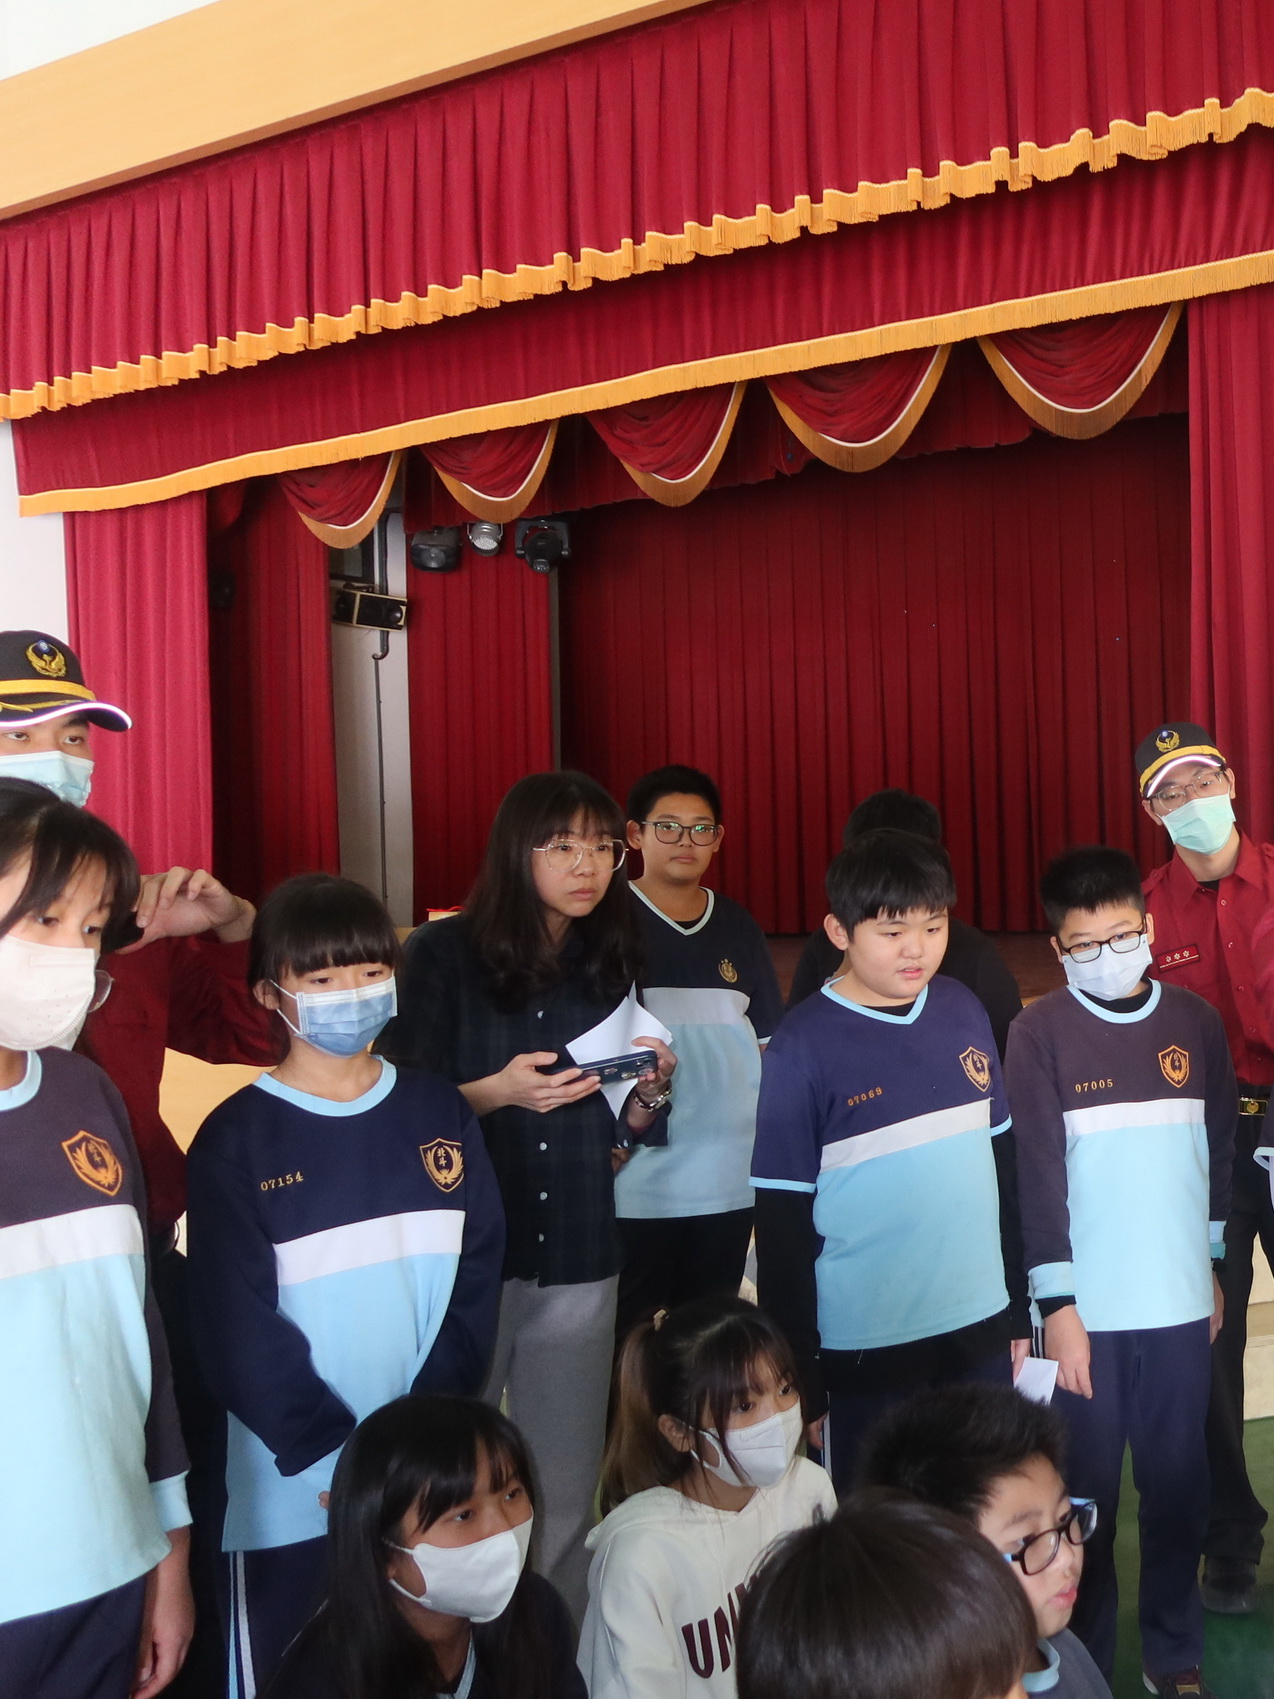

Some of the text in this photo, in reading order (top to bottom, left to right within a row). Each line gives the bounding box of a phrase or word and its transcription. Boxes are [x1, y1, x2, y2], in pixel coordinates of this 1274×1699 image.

[1075, 1078, 1114, 1093] 07005
[847, 1086, 883, 1106] 07069
[437, 1147, 448, 1167] 北斗
[260, 1171, 304, 1191] 07154
